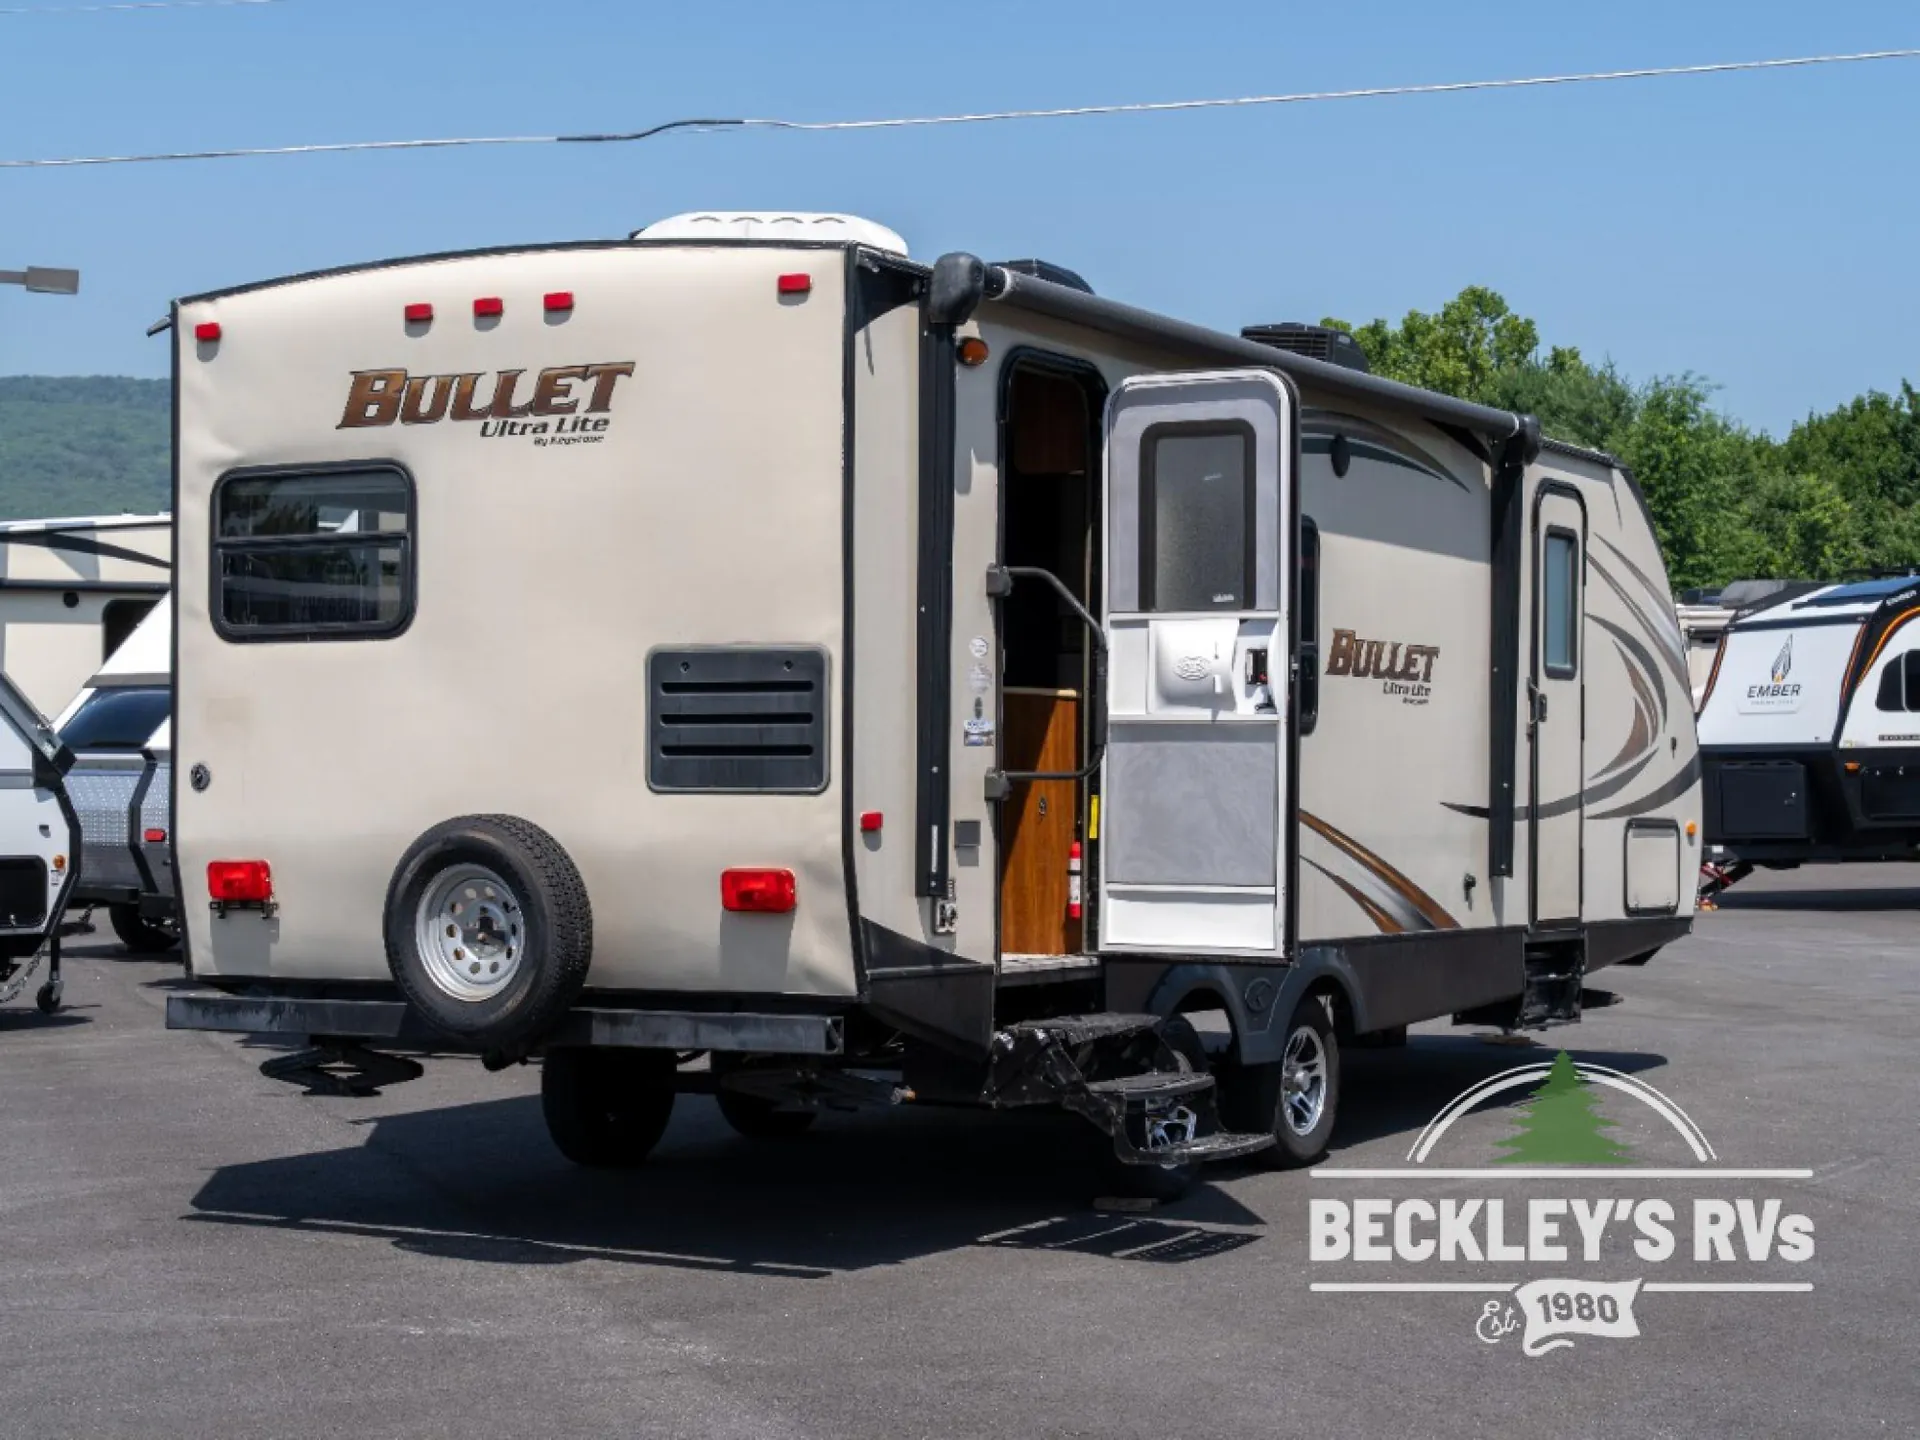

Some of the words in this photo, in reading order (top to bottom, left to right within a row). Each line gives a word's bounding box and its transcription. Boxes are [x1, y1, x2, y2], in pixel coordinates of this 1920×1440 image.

[335, 361, 636, 430] BULLET
[480, 419, 549, 437] Ultra
[555, 416, 610, 434] Lite
[1324, 628, 1440, 683] BULLET
[1747, 683, 1801, 698] EMBER
